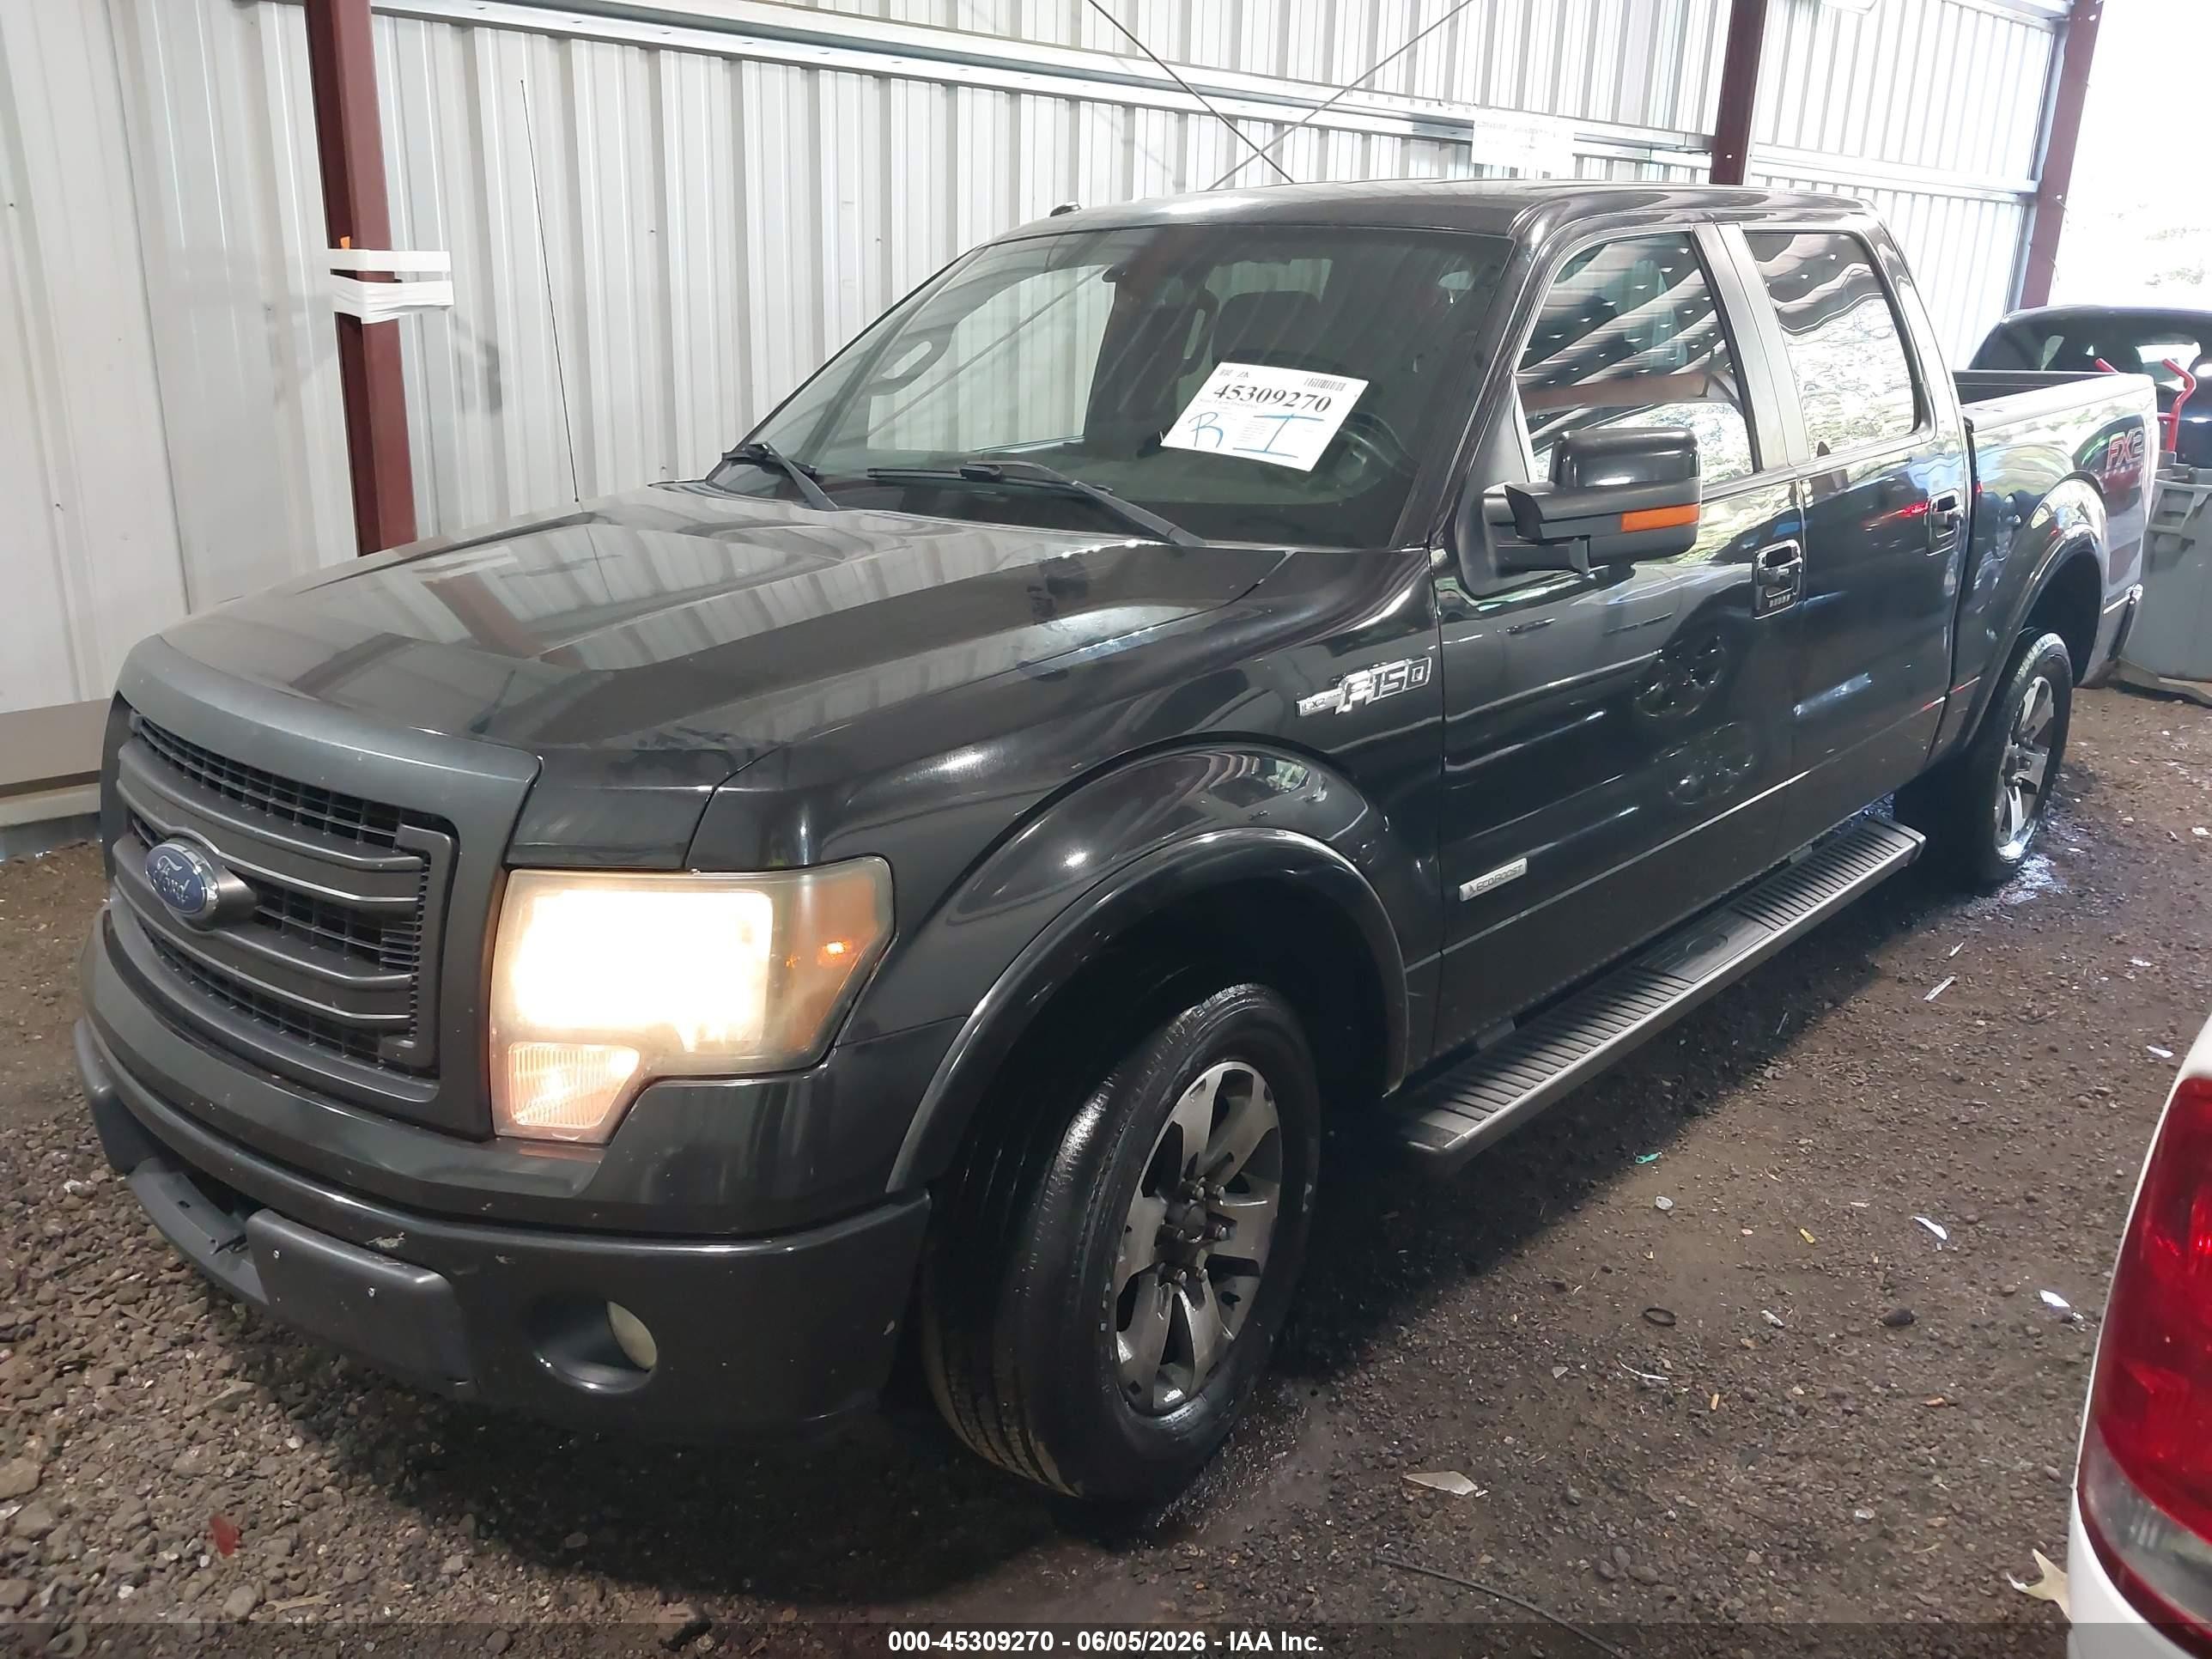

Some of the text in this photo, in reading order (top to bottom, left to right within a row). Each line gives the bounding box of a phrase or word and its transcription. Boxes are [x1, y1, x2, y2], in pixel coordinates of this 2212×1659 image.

[1213, 383, 1332, 413] 45309270
[2106, 427, 2144, 471] FX2
[154, 855, 191, 905] Ford
